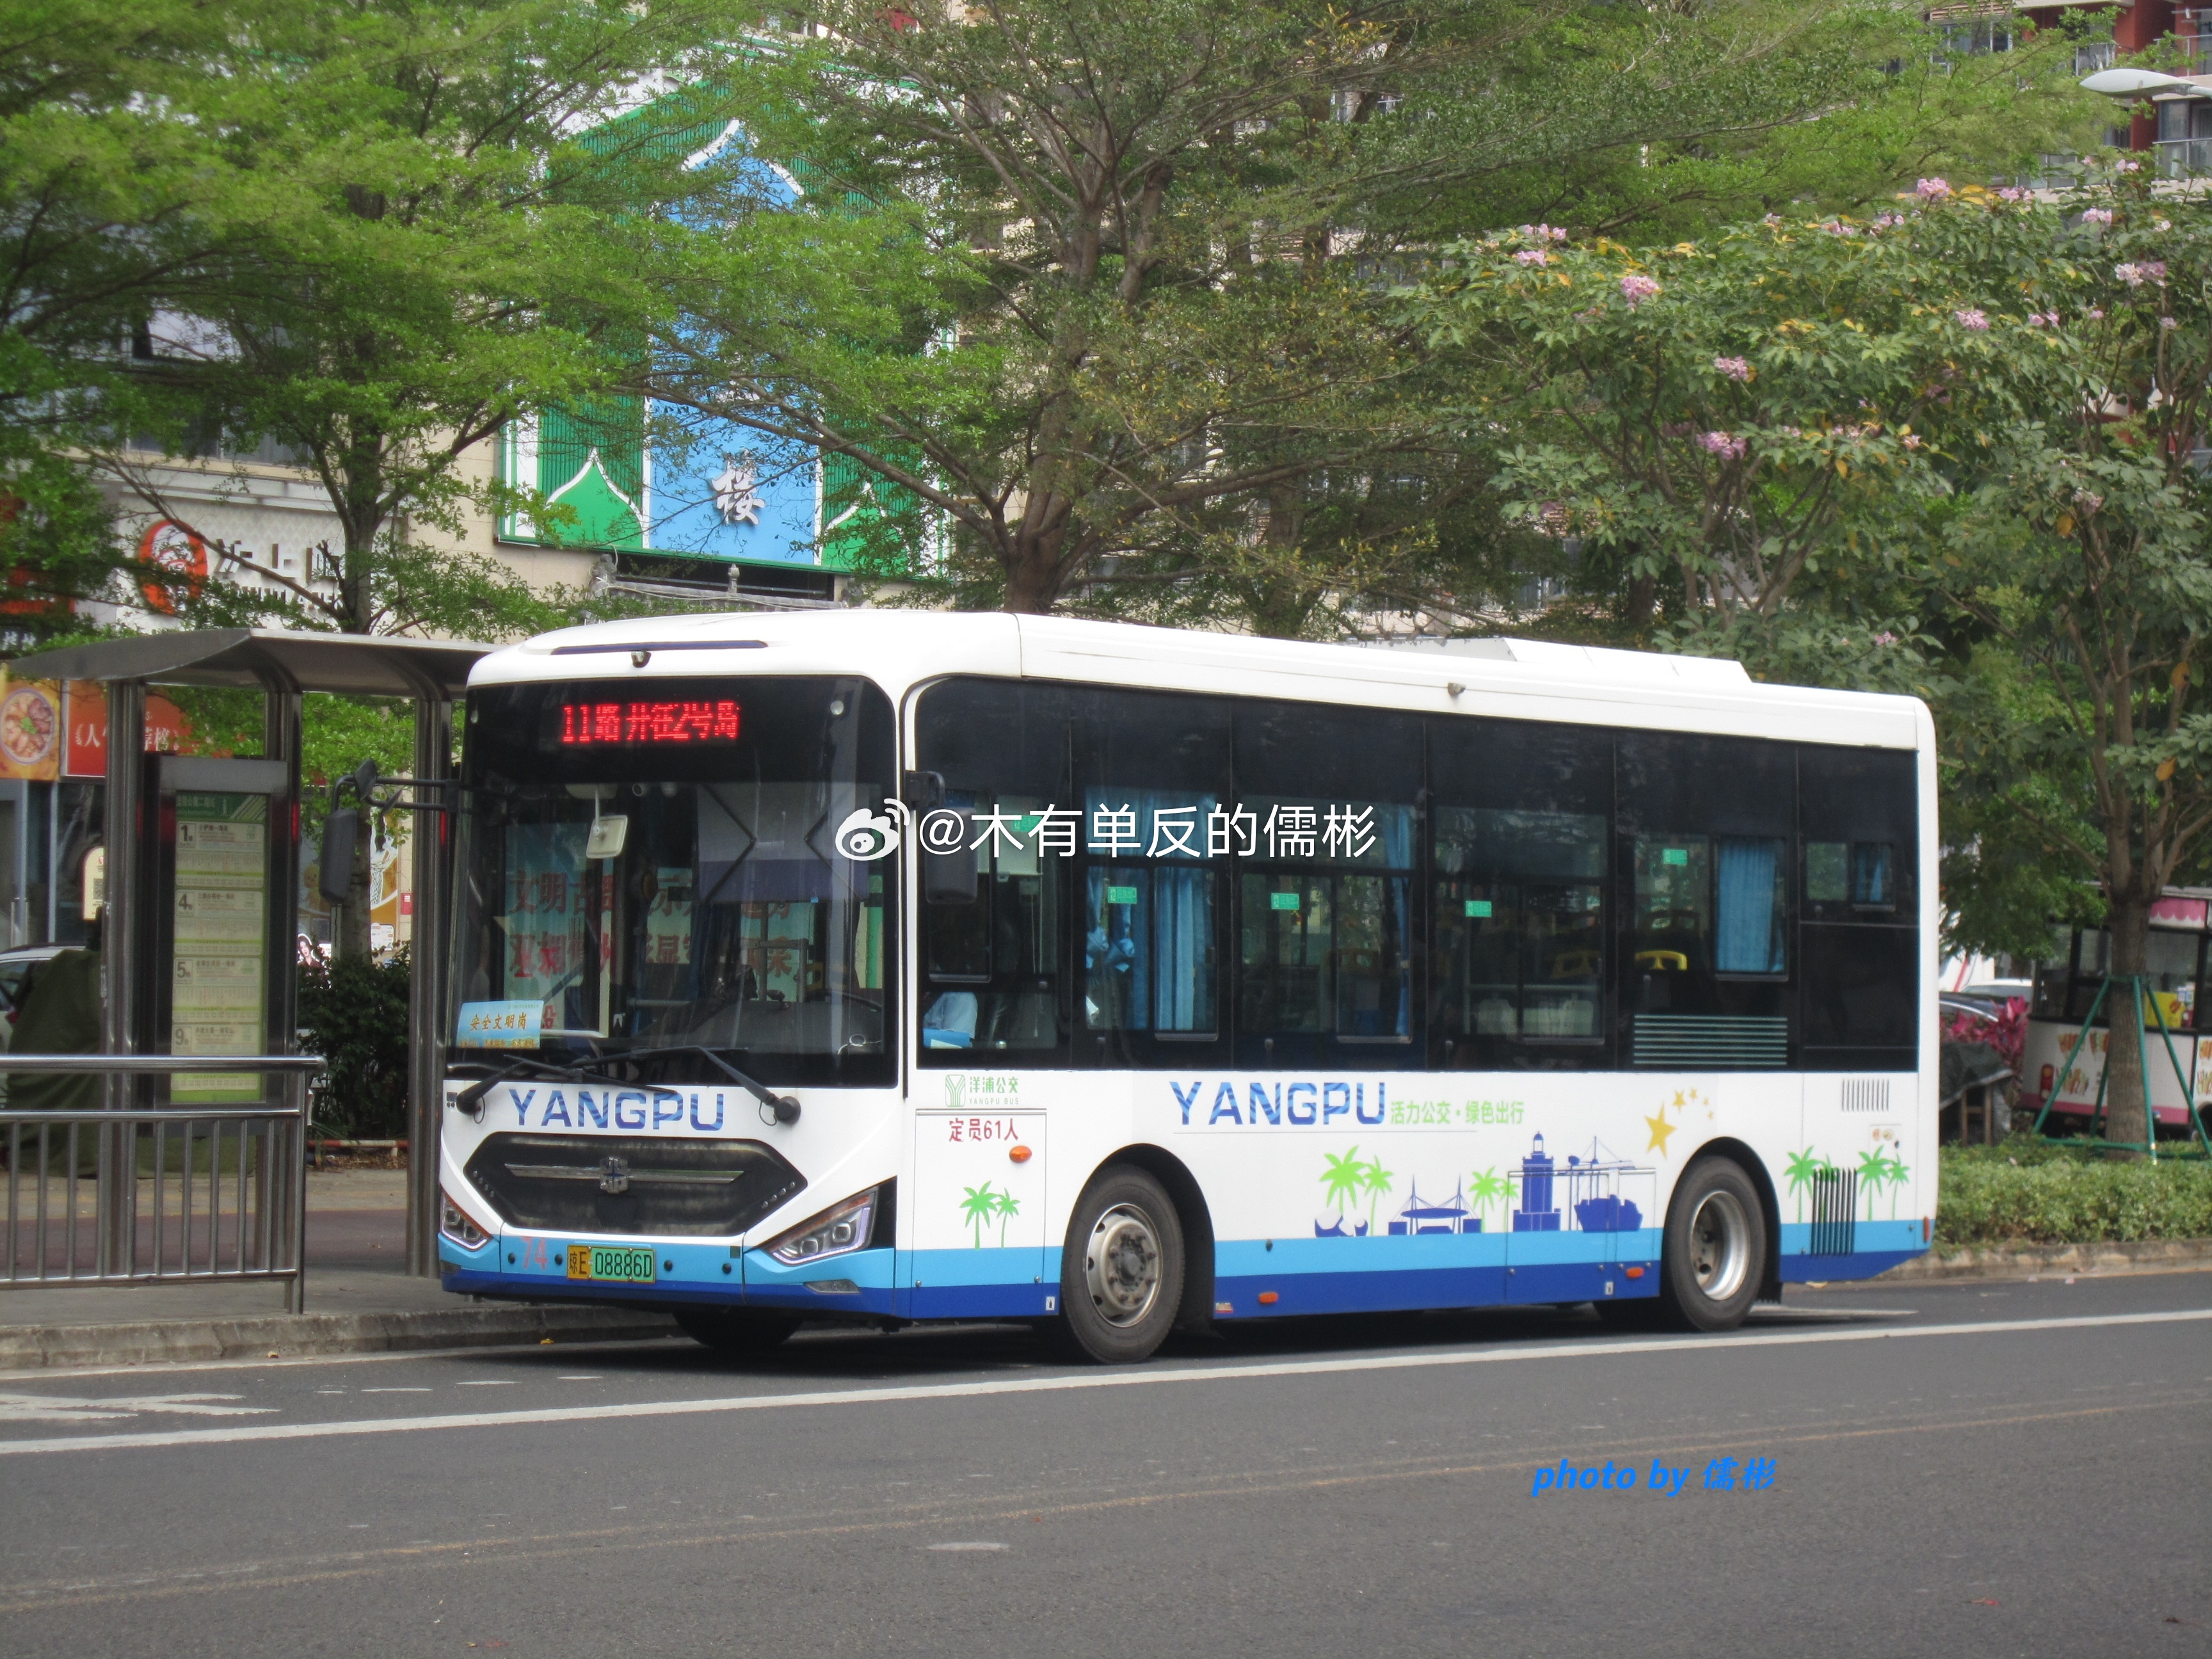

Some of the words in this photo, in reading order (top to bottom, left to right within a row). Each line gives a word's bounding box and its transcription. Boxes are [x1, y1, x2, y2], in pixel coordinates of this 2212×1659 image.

[470, 1012, 527, 1031] 安全文明岗
[970, 1076, 1019, 1094] 洋浦公交
[508, 1088, 725, 1132] YANGPU
[968, 1097, 1000, 1105] YANGPU
[1004, 1097, 1020, 1105] BUS
[1169, 1082, 1386, 1126] YANGPU
[949, 1117, 1020, 1142] 定员61人
[521, 1235, 549, 1270] 74
